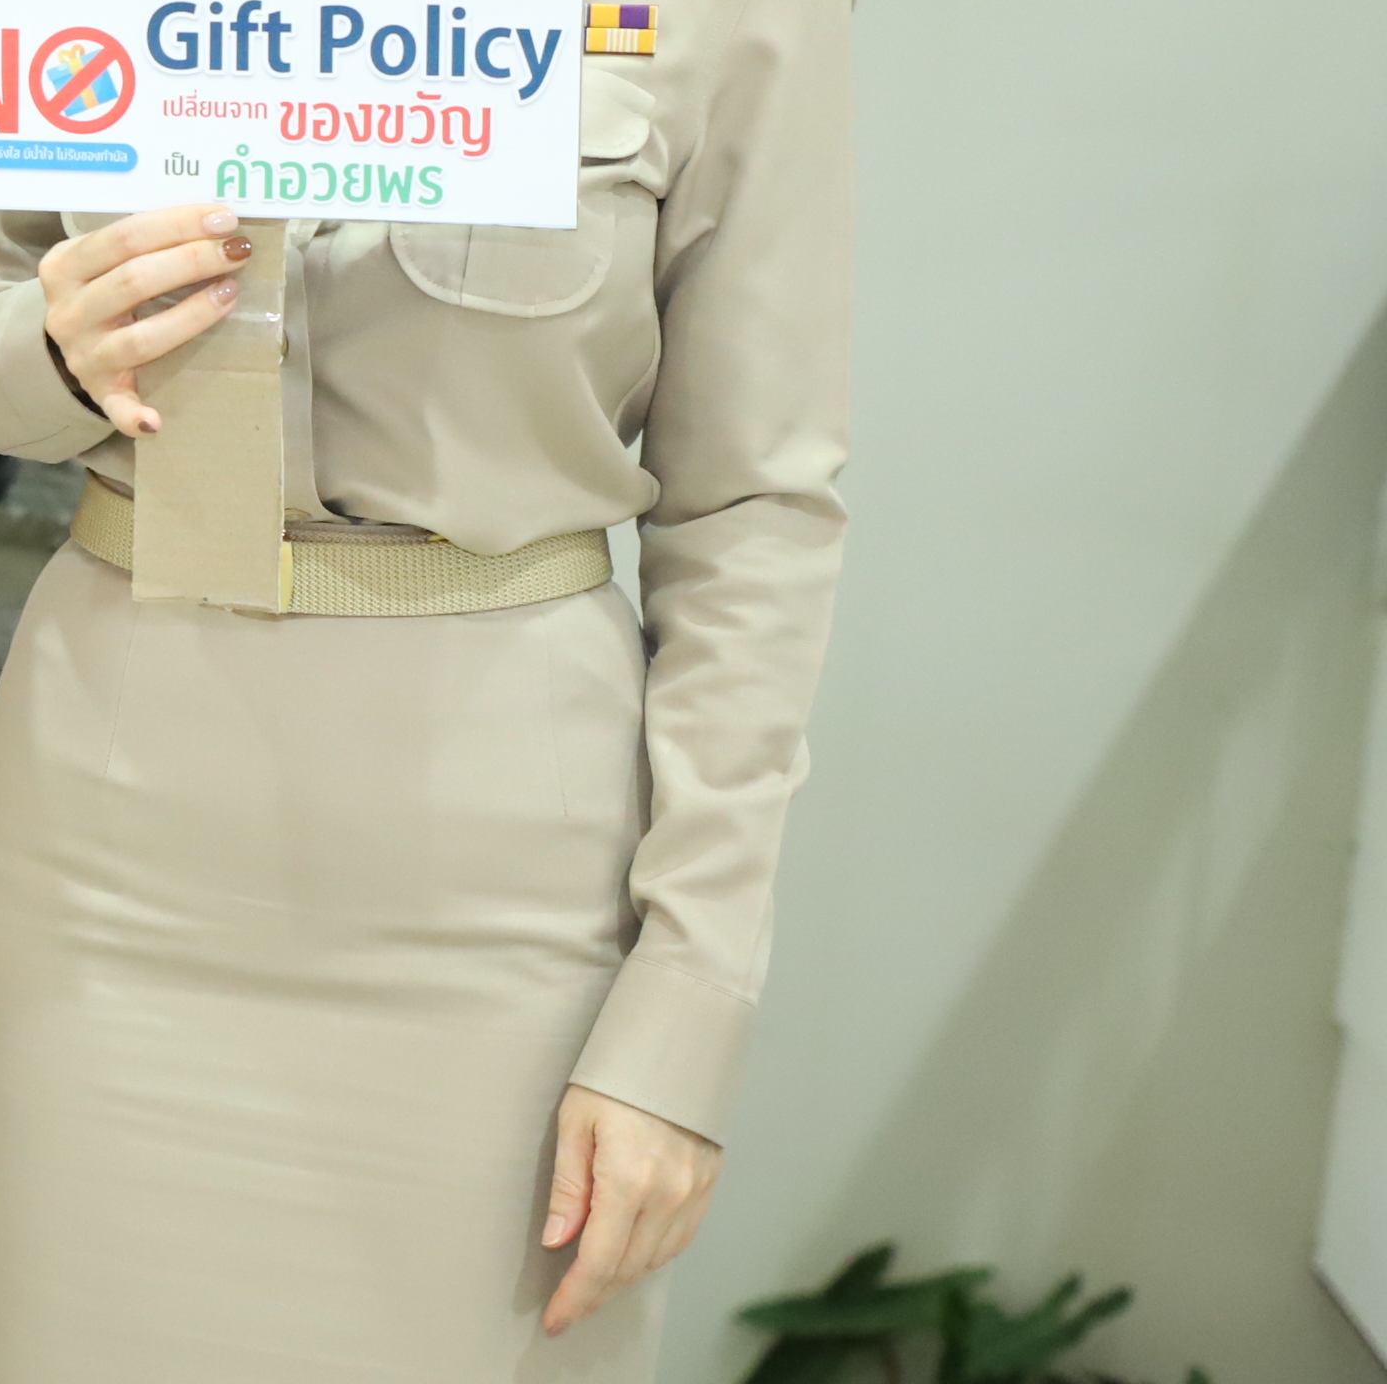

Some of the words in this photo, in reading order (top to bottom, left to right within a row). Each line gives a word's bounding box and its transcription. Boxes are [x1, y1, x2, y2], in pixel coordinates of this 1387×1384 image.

[146, 0, 292, 73] Gift
[319, 3, 563, 101] Policy
[162, 88, 268, 120] เปลี่ยนจาก
[279, 90, 492, 157] ของขวัญ
[164, 152, 200, 177] เป็น
[215, 143, 444, 206] คำอวยพร
